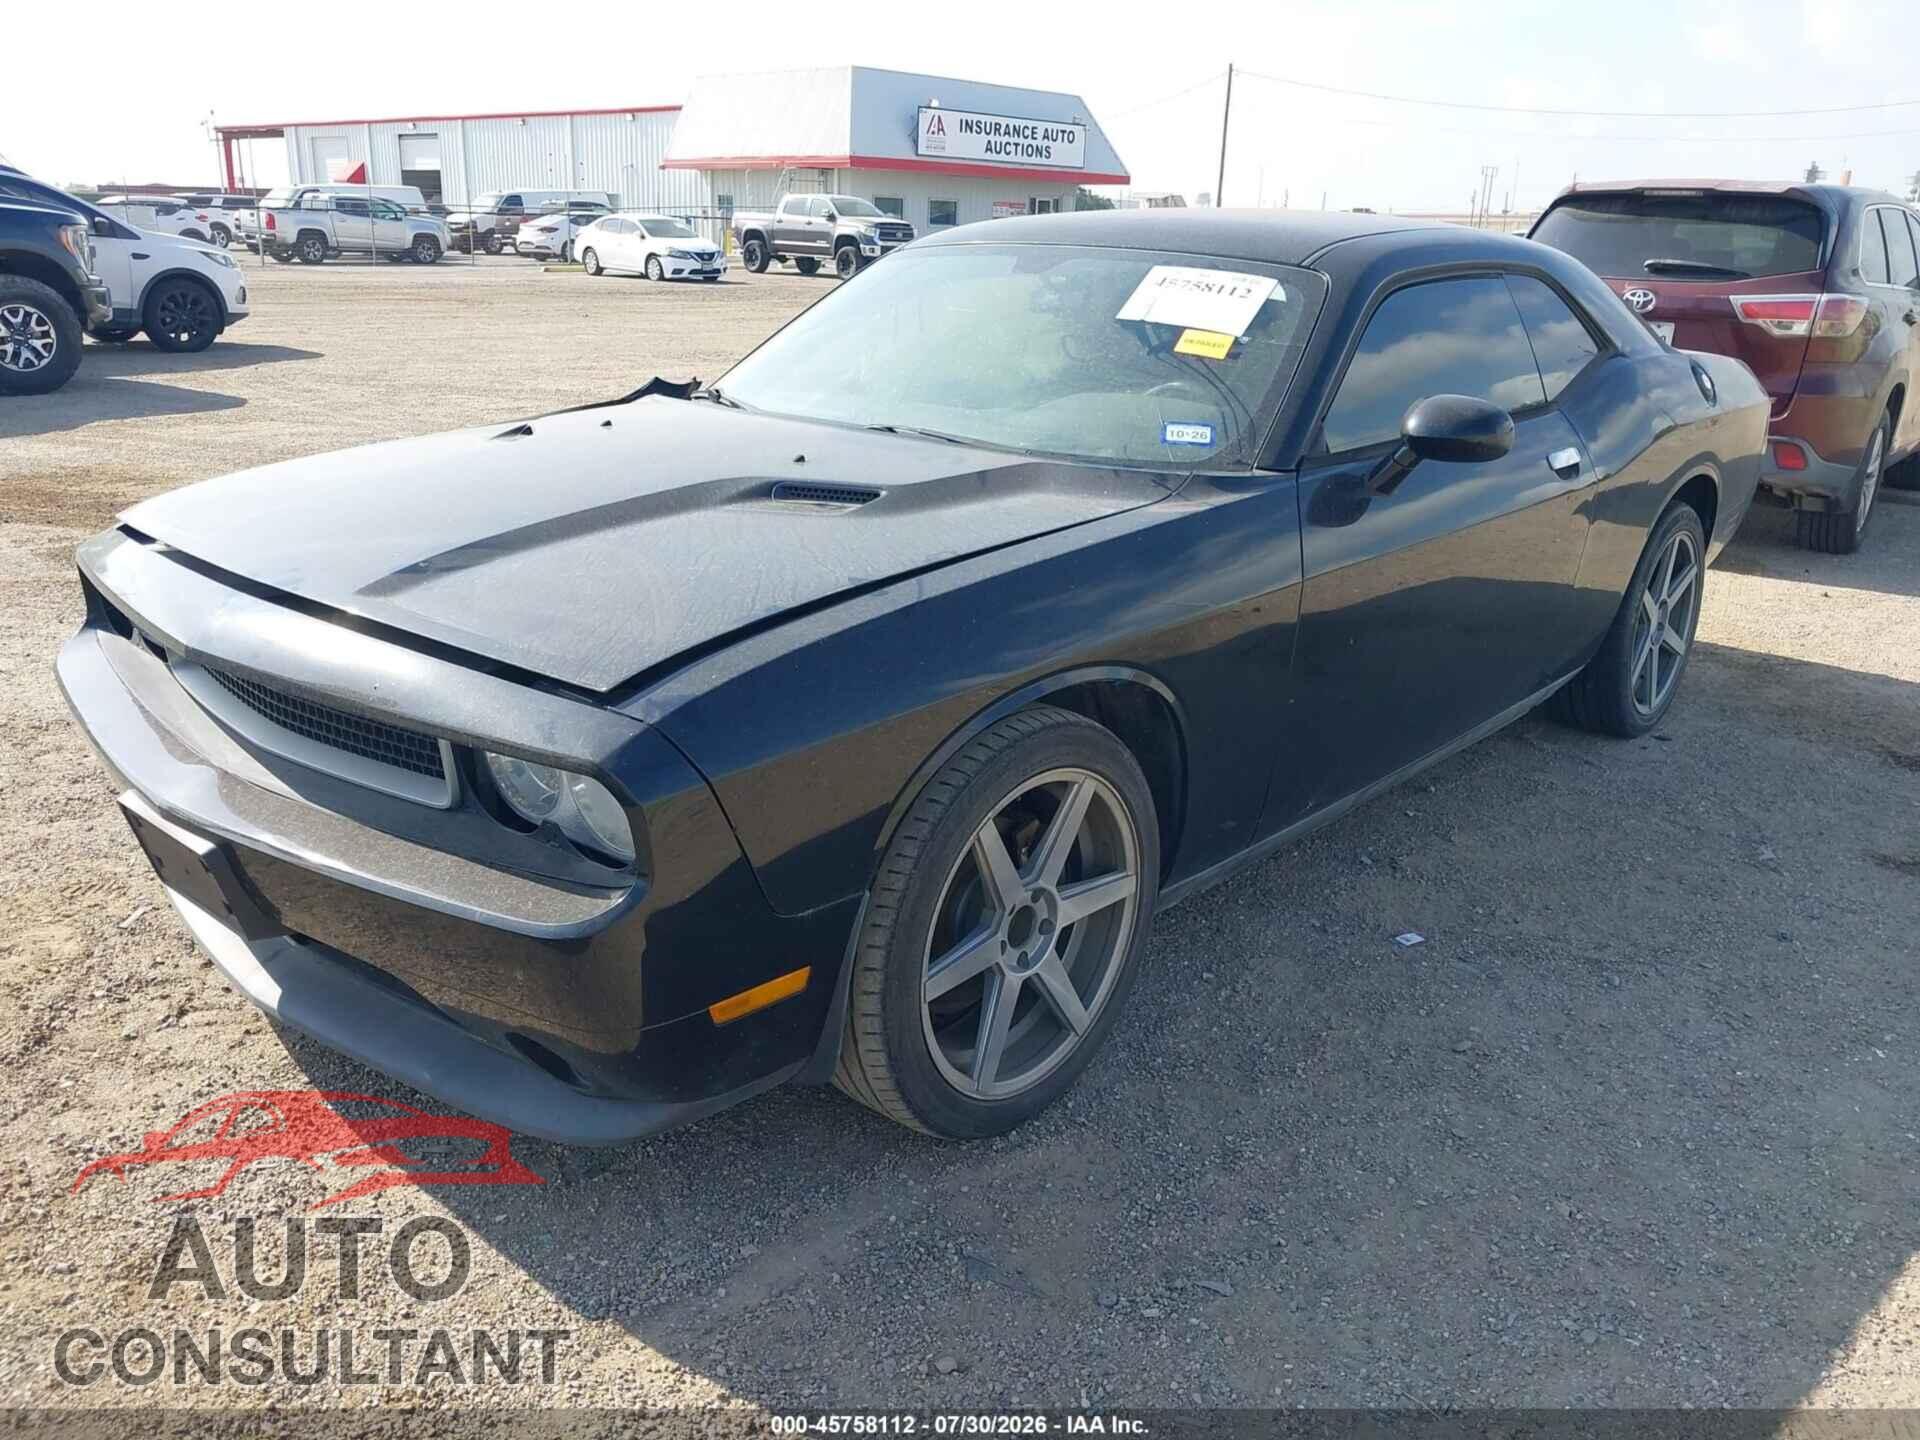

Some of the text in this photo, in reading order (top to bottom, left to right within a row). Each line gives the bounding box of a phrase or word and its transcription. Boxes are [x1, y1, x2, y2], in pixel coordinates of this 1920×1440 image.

[959, 118, 1076, 144] INSURANCE AUTO
[984, 140, 1052, 160] AUCTIONS
